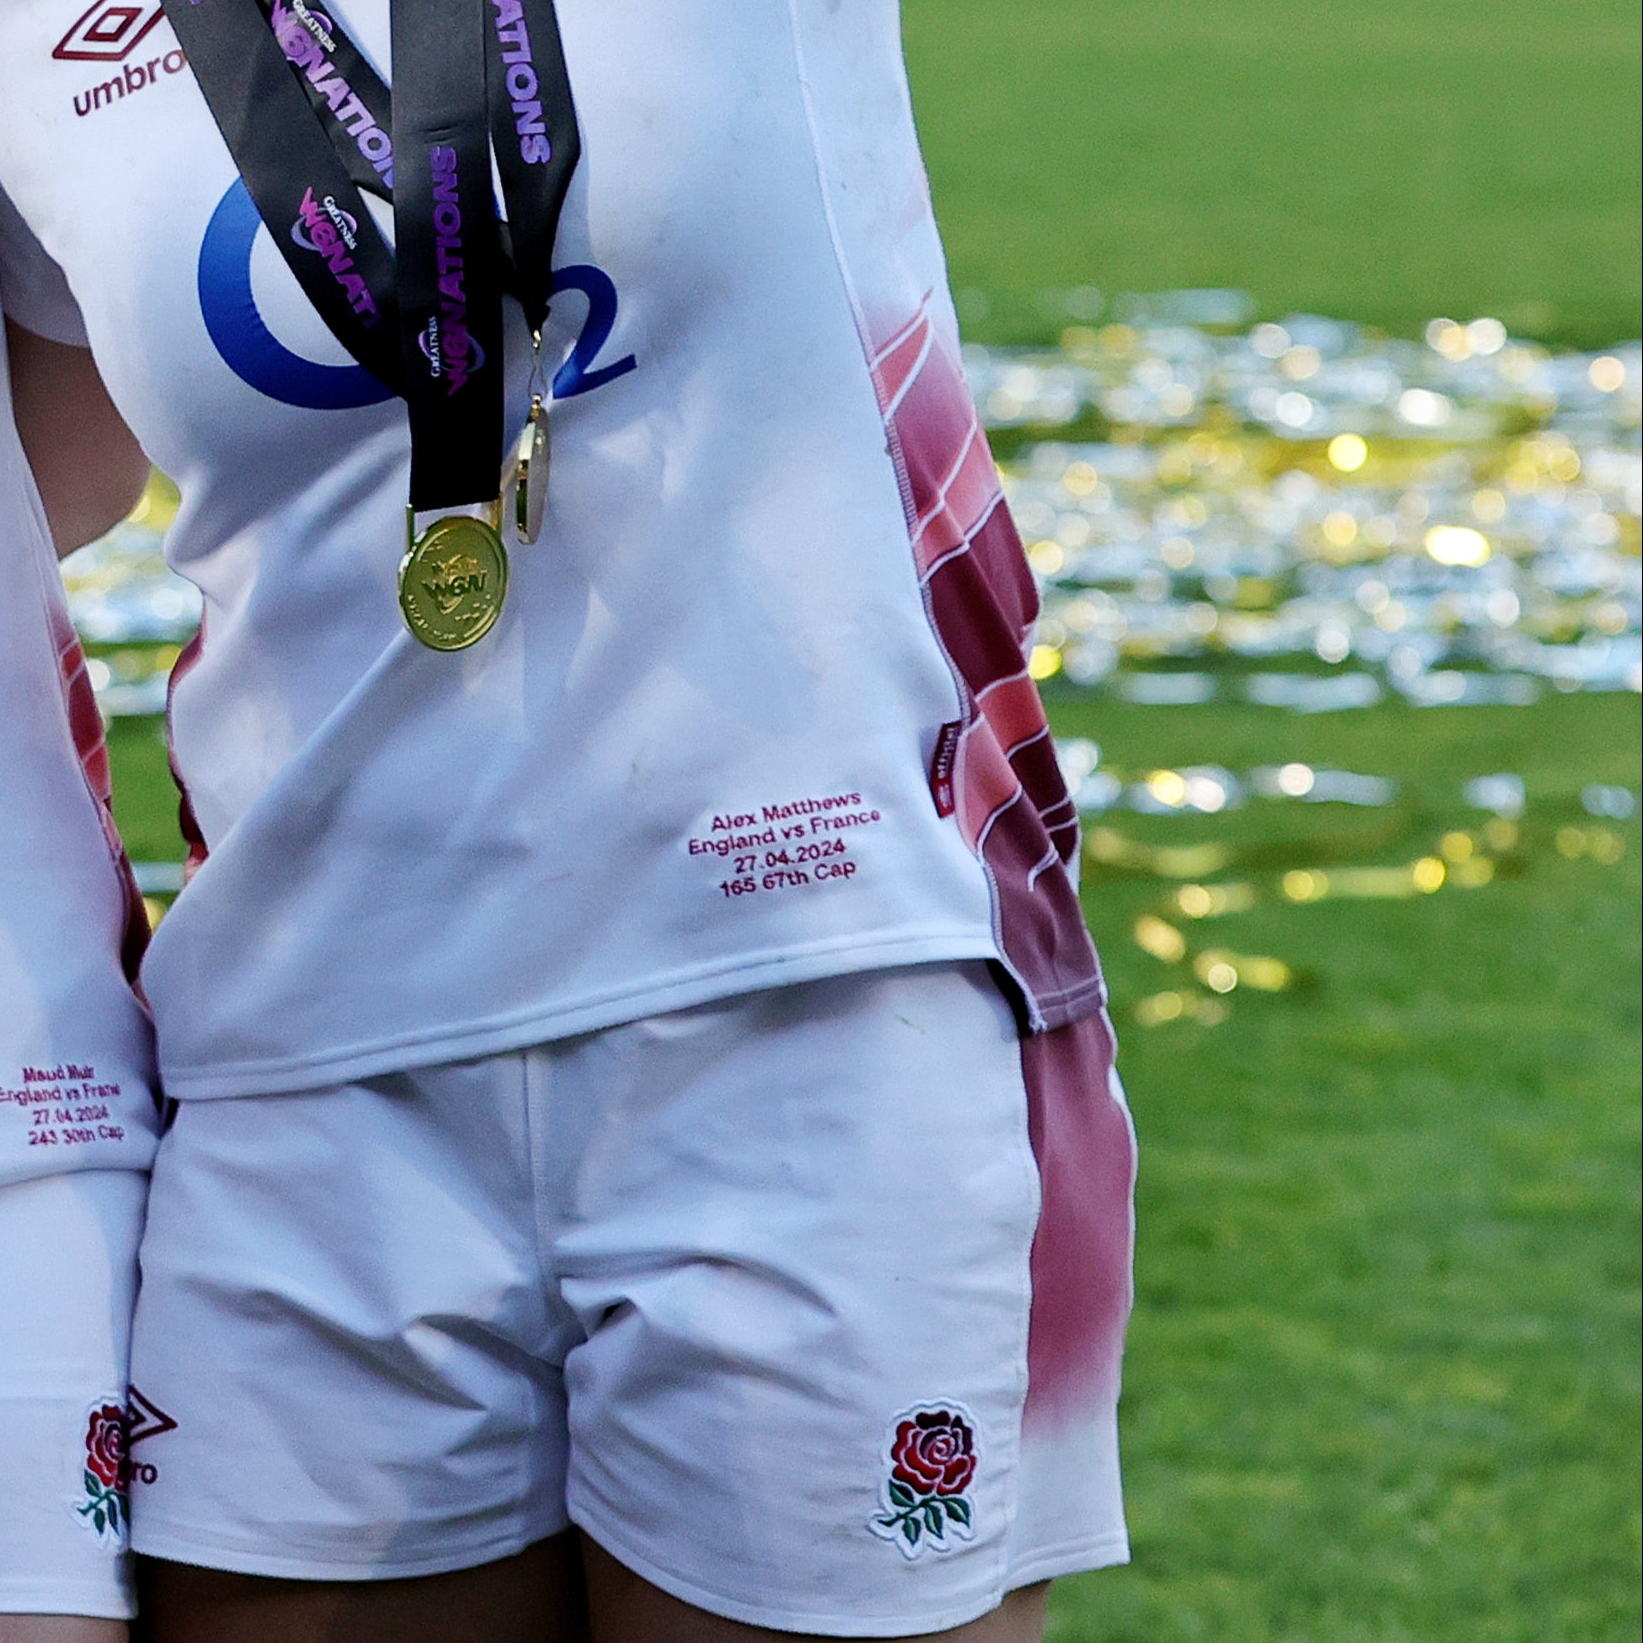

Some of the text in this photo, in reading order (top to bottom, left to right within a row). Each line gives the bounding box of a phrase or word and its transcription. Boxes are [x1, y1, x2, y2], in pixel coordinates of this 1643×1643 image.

[72, 49, 189, 117] umbro
[761, 792, 862, 823] Matthews
[689, 810, 881, 857] England vs France
[720, 861, 856, 898] 165 67th Cap
